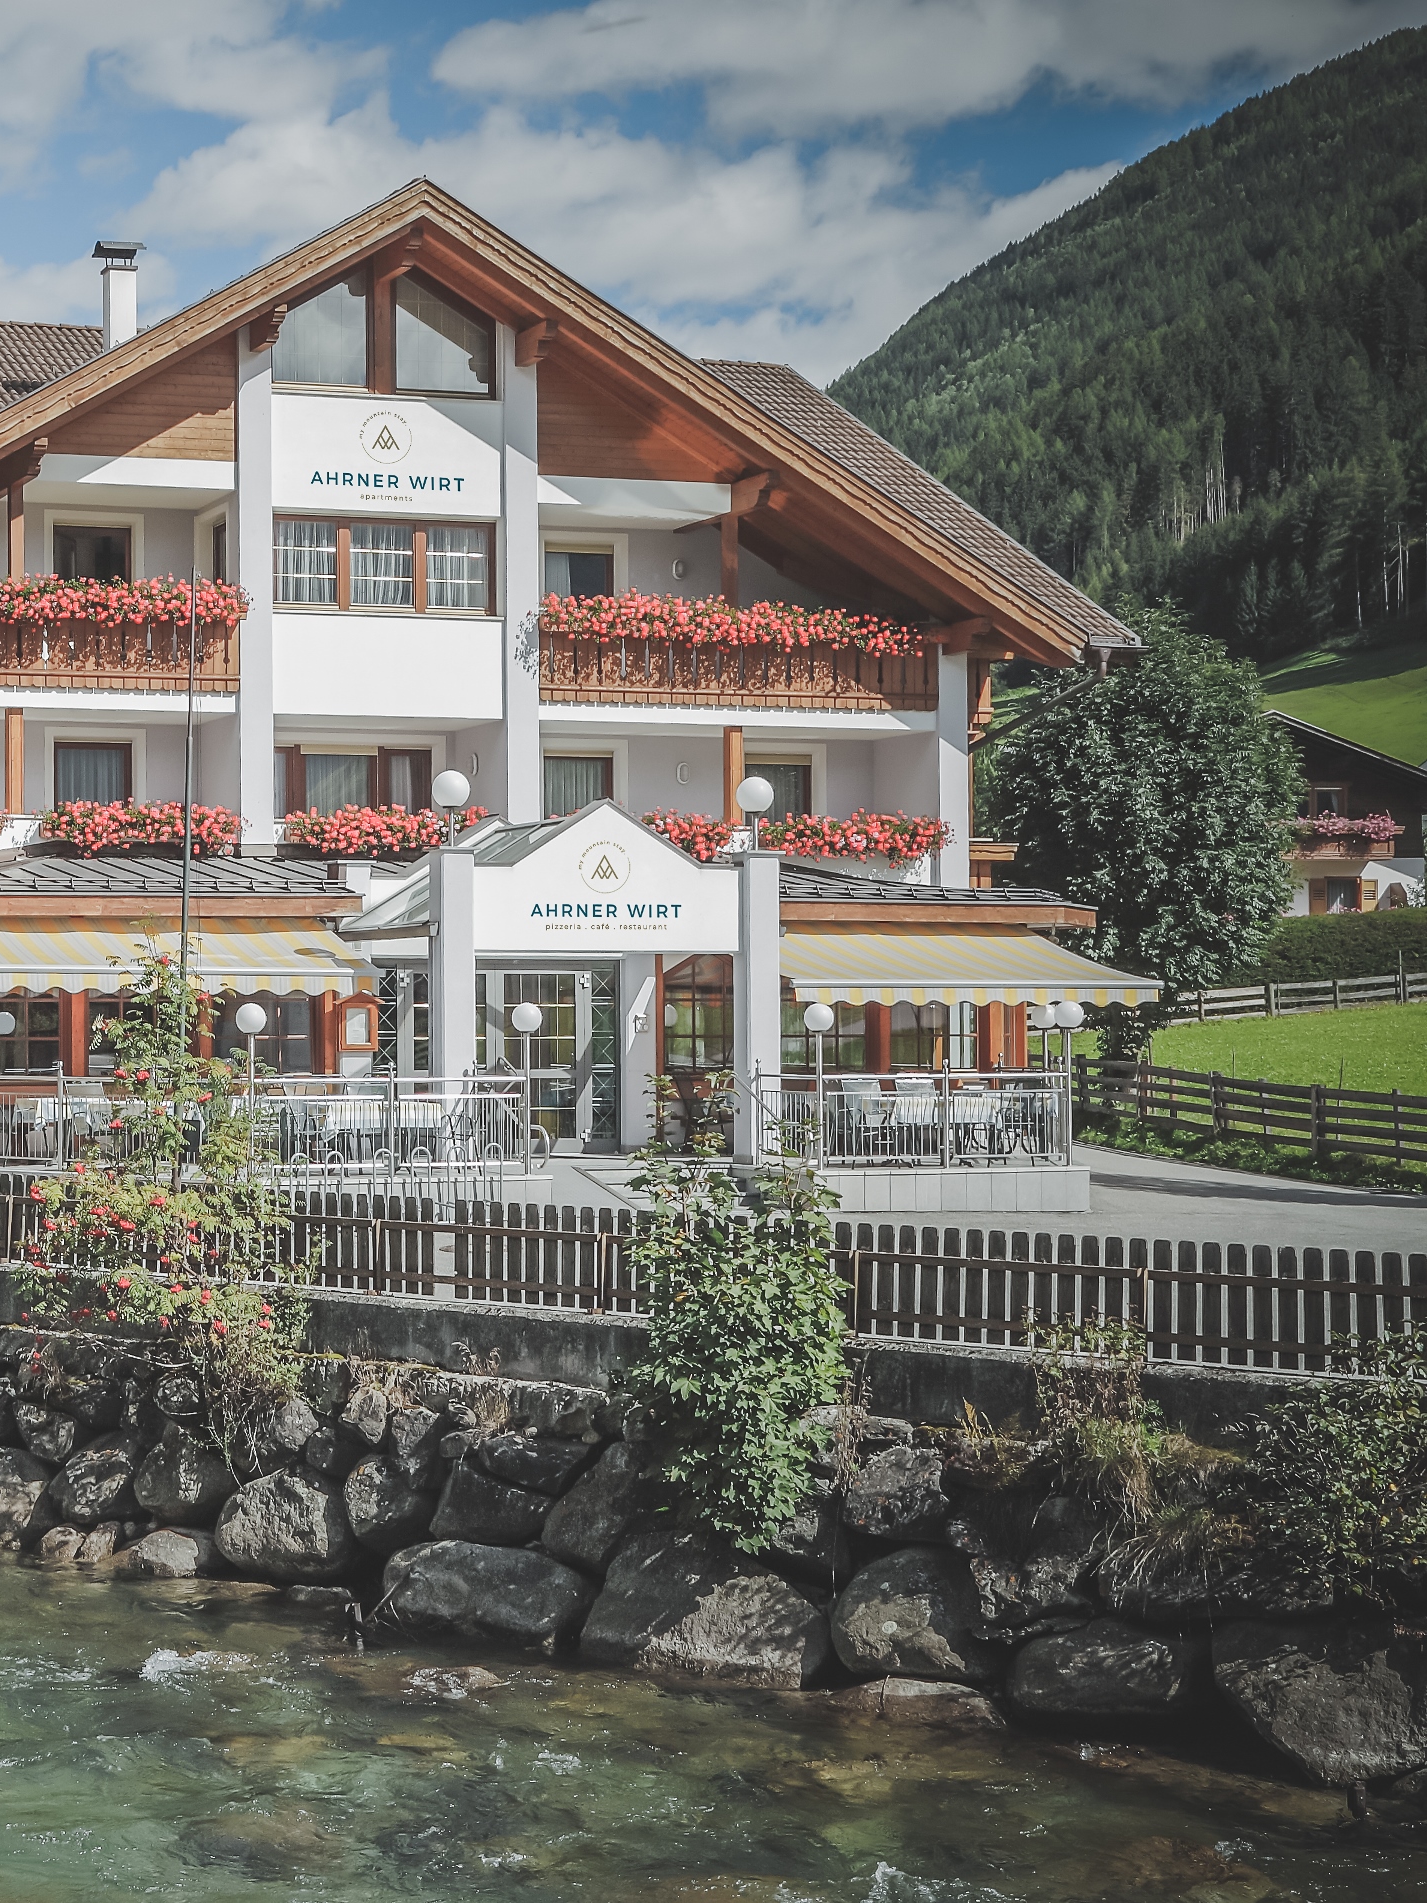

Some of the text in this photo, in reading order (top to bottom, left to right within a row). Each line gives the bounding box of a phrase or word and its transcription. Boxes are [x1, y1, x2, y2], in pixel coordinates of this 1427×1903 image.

[311, 471, 466, 492] AHRNER WIRT
[360, 493, 413, 502] apartments
[530, 903, 682, 918] AHRNER WIRT
[545, 923, 582, 931] pizzeria
